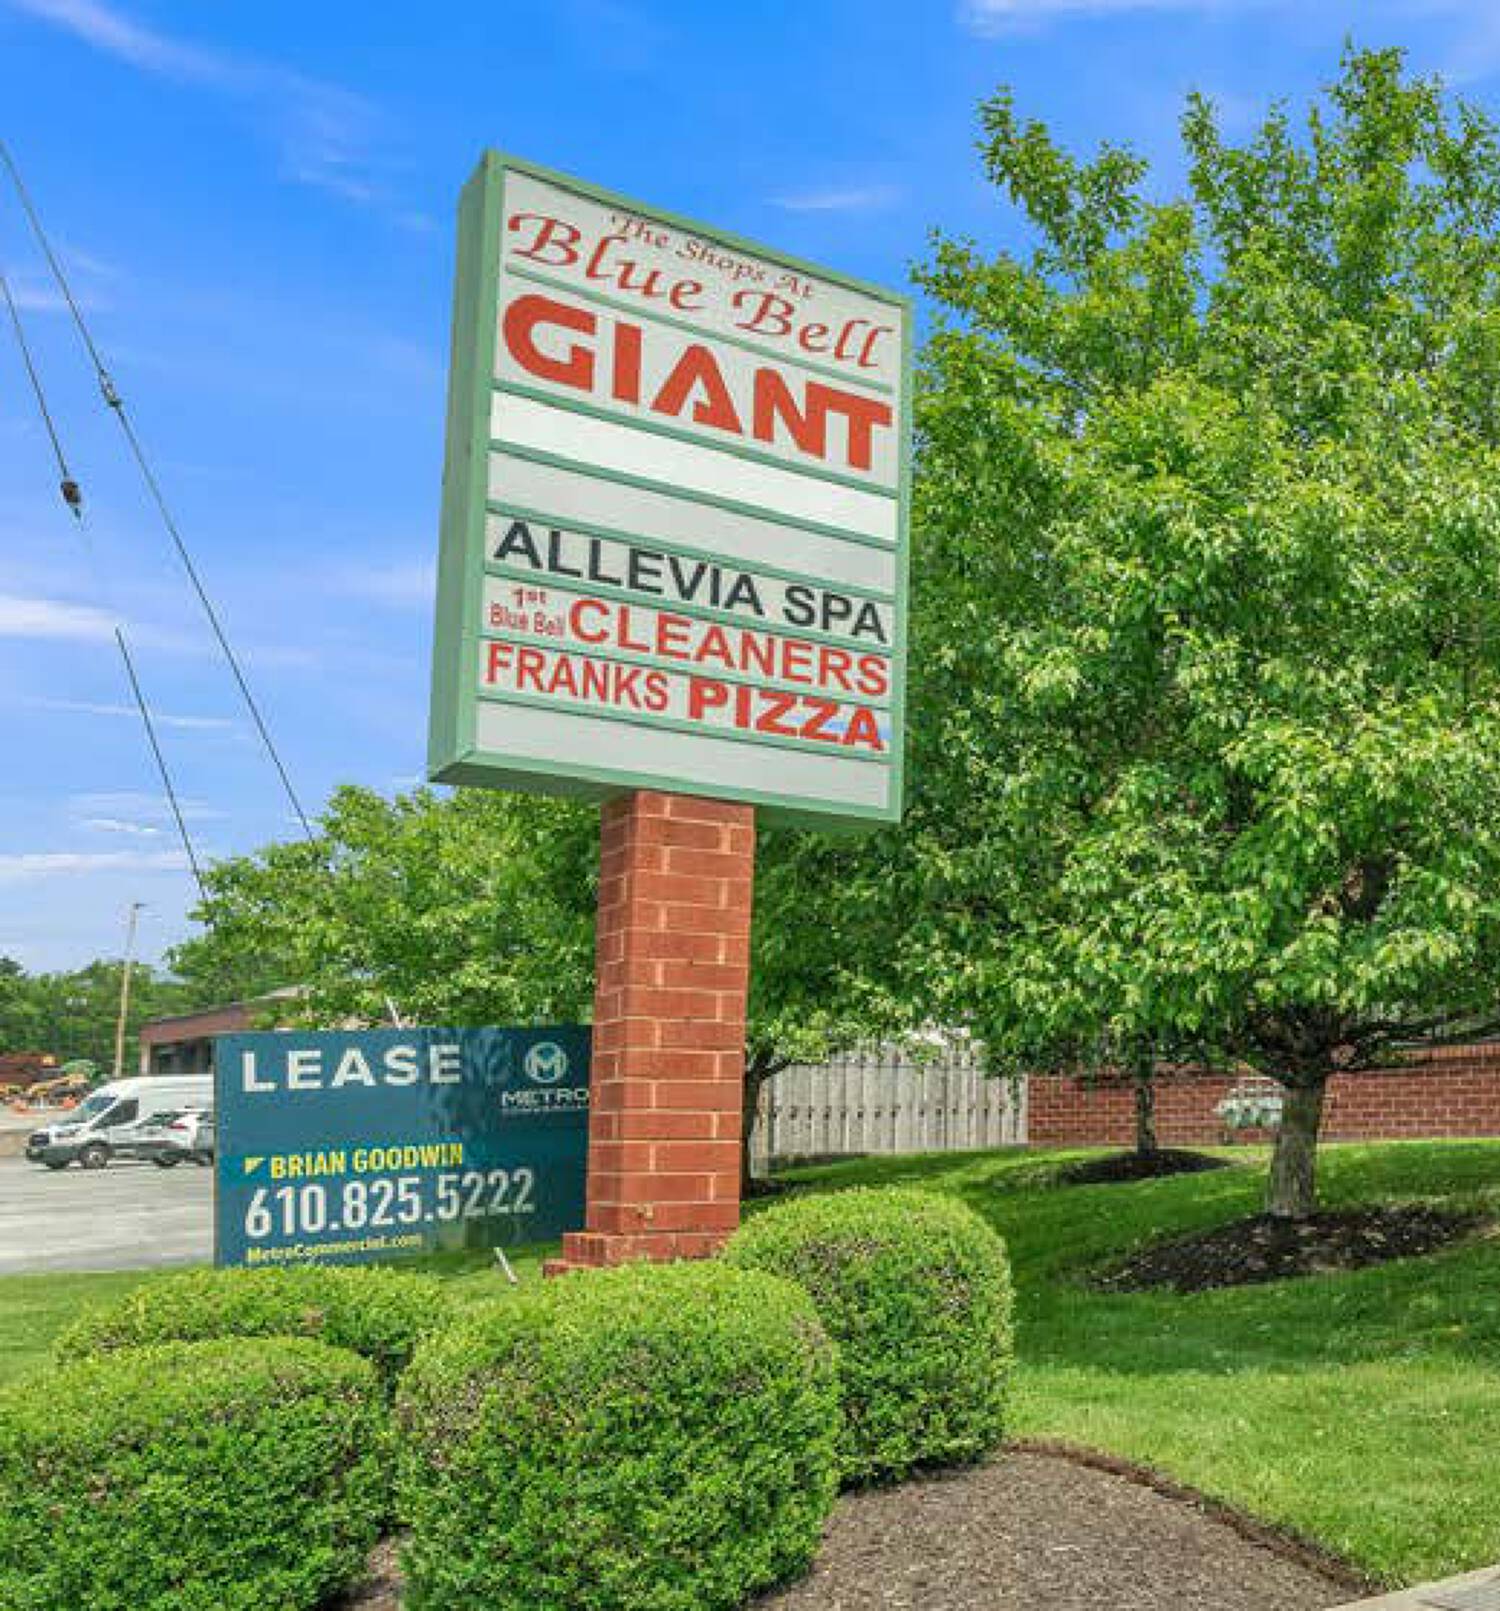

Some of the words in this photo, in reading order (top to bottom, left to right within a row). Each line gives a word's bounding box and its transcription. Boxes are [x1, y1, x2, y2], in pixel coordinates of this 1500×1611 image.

[508, 213, 704, 311] Blue
[732, 290, 894, 368] Bell
[611, 214, 669, 249] The
[675, 239, 766, 281] Shops
[774, 273, 814, 298] At
[502, 293, 893, 472] GIANT
[490, 603, 528, 632] Blue
[534, 611, 565, 637] Bell
[494, 520, 765, 617] ALLEVIA
[782, 584, 888, 644] SPA
[511, 587, 547, 608] 1st
[568, 598, 889, 697] CLEANERS
[486, 642, 669, 712] FRANKS
[688, 676, 885, 751] PIZZA
[241, 1044, 463, 1093] LEASE
[501, 1088, 590, 1108] METRO
[270, 1151, 346, 1179] BRIAN
[353, 1143, 464, 1173] GOODWIN
[244, 1167, 536, 1239] 610.825.5222
